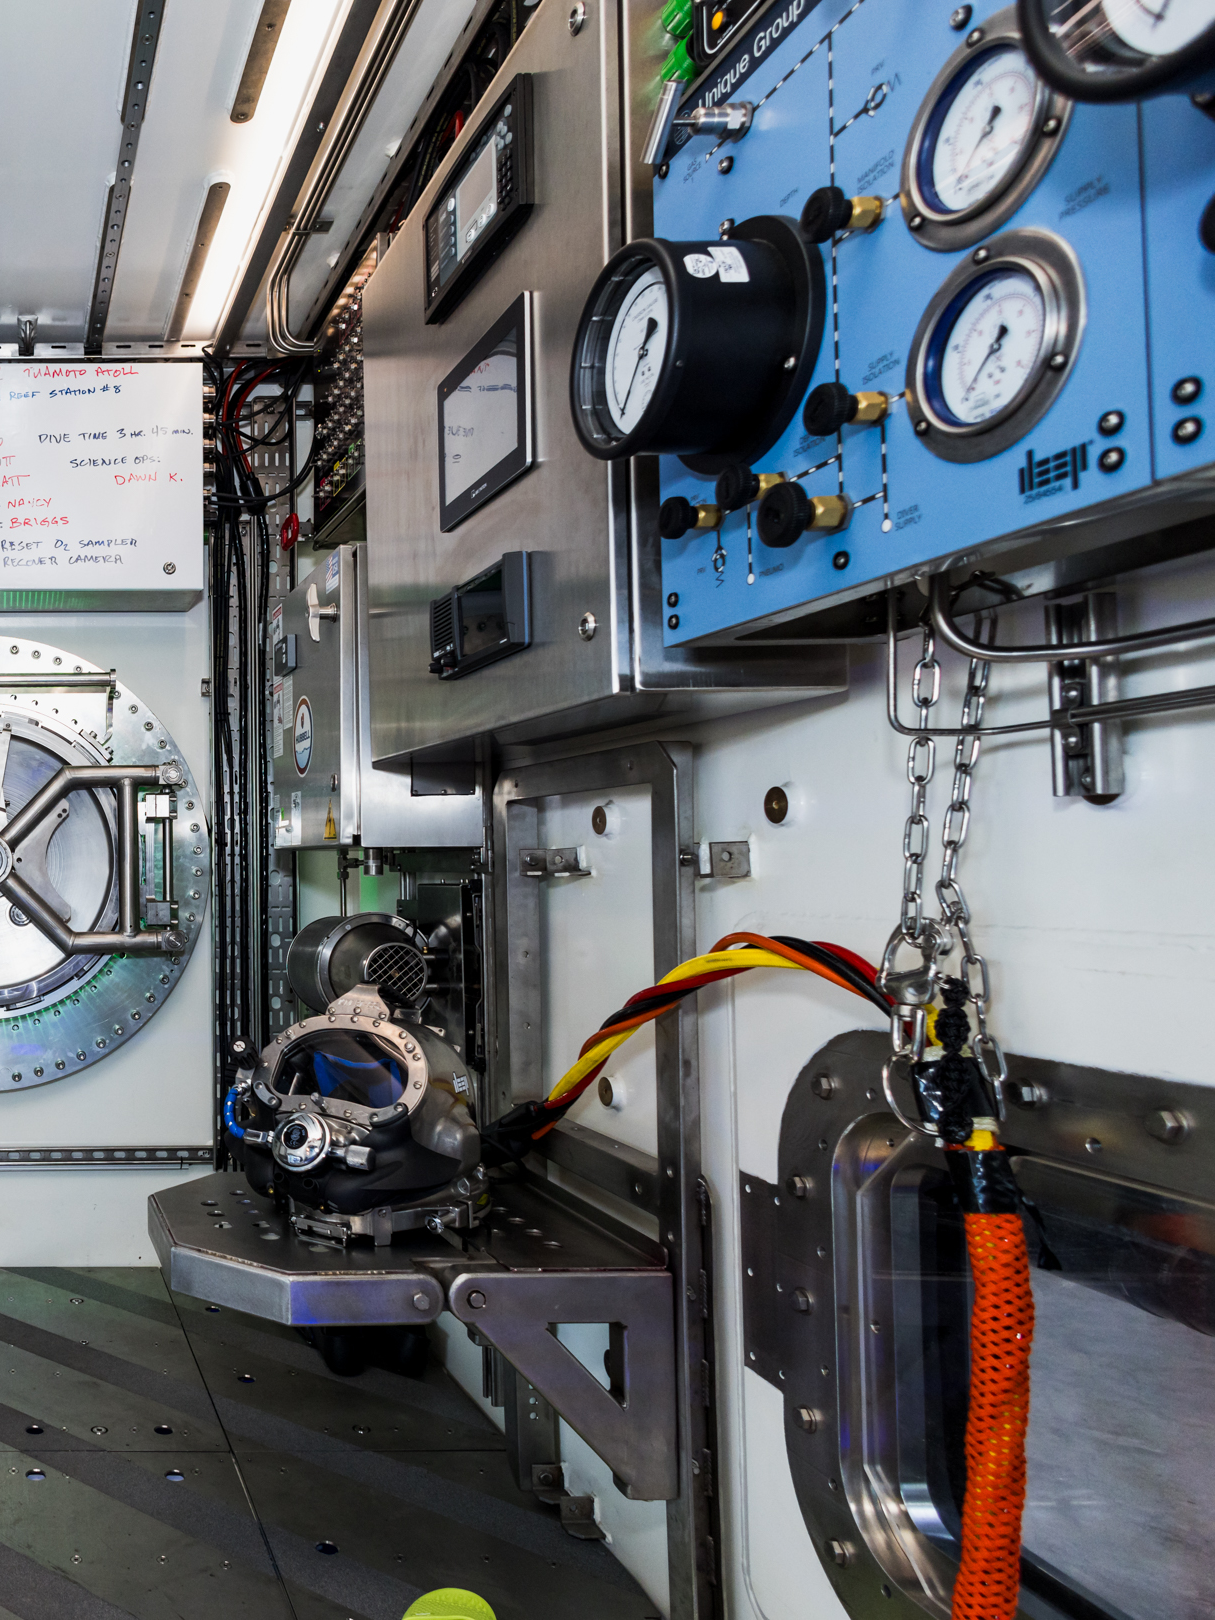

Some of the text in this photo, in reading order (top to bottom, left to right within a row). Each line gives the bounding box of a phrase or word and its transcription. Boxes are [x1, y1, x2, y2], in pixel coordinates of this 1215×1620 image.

[698, 0, 805, 109] Unique Group
[856, 149, 895, 184] MANIFOLD
[856, 160, 896, 195] ISOLATION
[867, 350, 894, 371] SUPPLY
[94, 365, 140, 378] ATOLL
[862, 357, 900, 386] ISOLATION
[8, 390, 41, 401] REEF
[49, 385, 96, 399] STATION
[114, 384, 123, 394] 8
[38, 433, 72, 444] DIVE
[78, 431, 108, 441] TIME
[116, 428, 127, 439] 3
[151, 424, 169, 438] 45
[69, 454, 161, 468] SCIENCE OPS:
[114, 471, 184, 486] DAWN K.
[896, 504, 920, 520] DIVER
[9, 516, 70, 529] BRIGGS
[894, 512, 922, 532] SUPPLY
[0, 539, 44, 552] RESET
[78, 537, 138, 548] SAMPLER
[2, 555, 59, 568] RECOVER
[68, 554, 124, 566] CAMERA
[296, 729, 311, 745] HUBBELL
